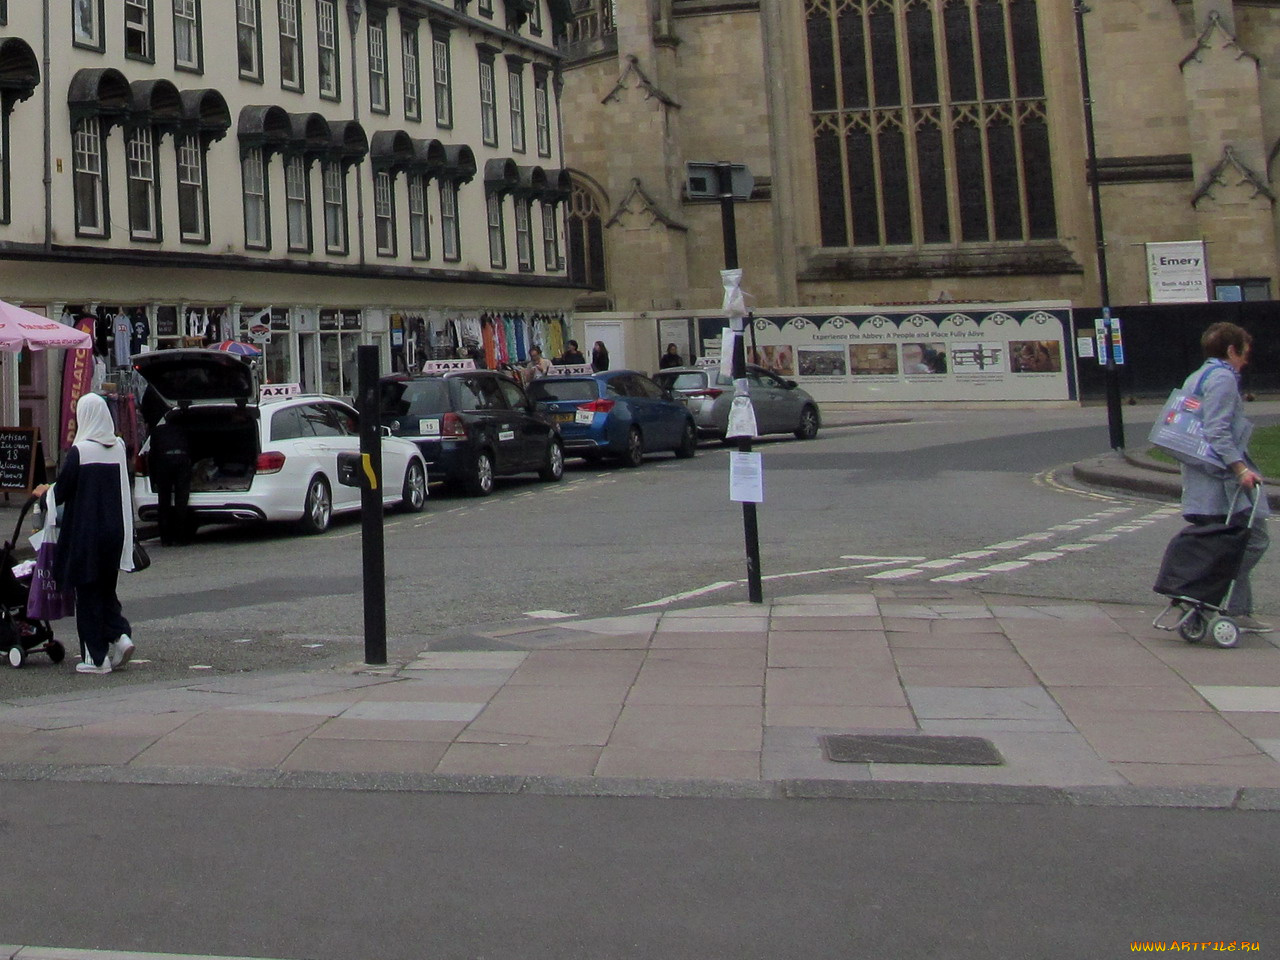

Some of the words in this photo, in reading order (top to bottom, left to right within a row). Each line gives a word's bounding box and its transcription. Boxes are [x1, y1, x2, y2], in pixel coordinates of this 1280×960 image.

[1160, 256, 1200, 266] Emery
[893, 332, 915, 340] People
[260, 388, 289, 396] AXI
[0, 433, 27, 441] Artisan
[7, 449, 18, 460] 18
